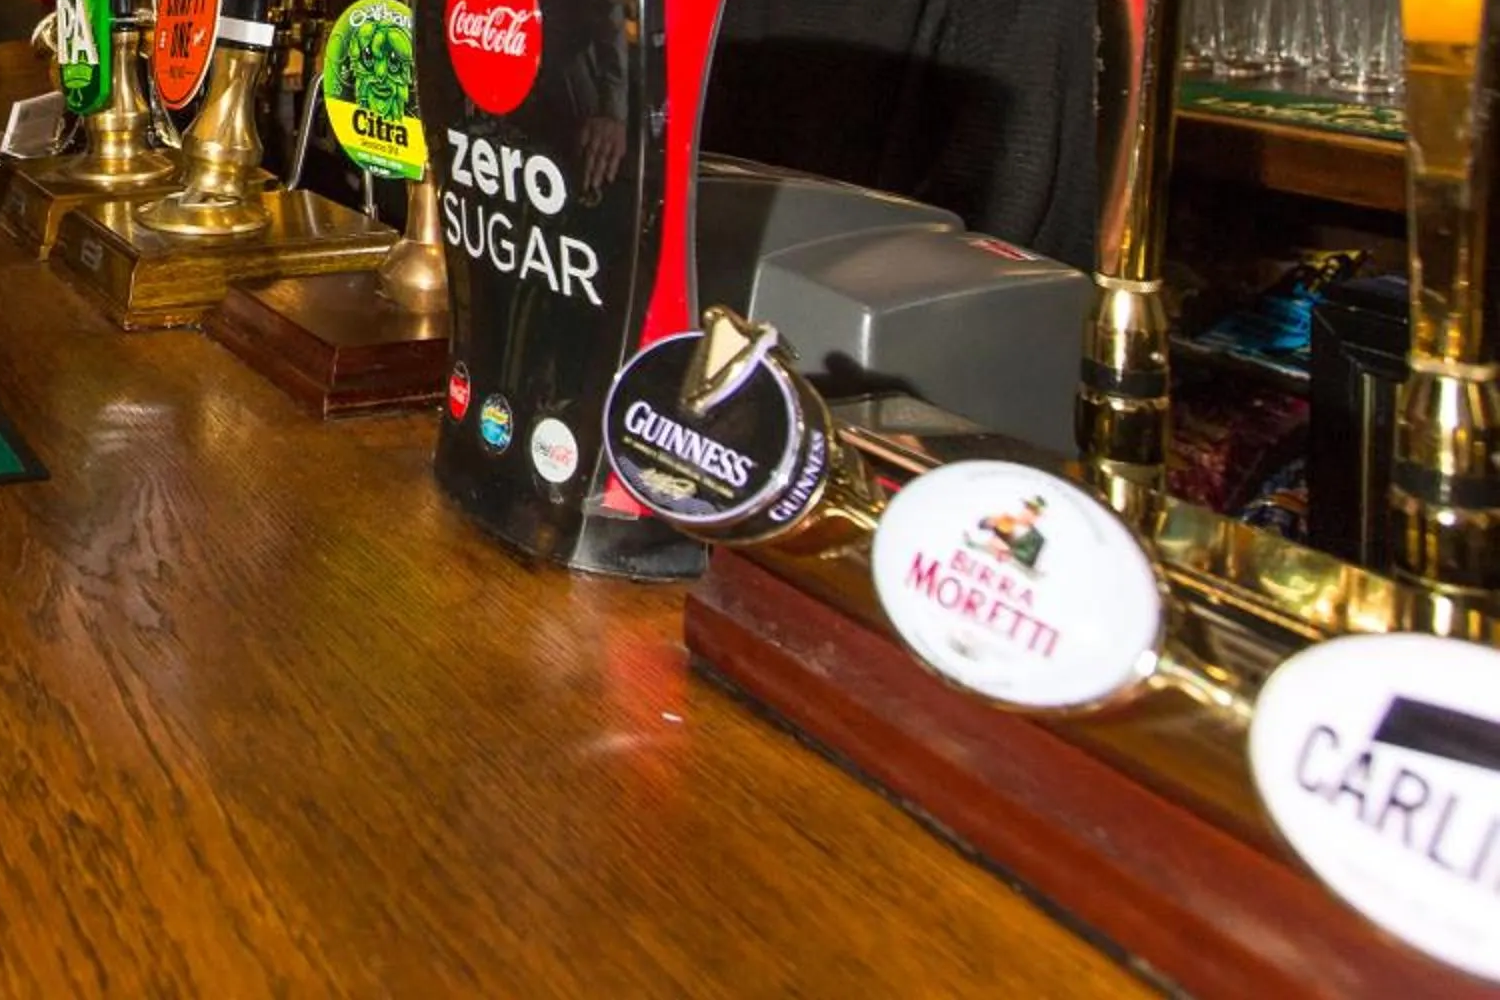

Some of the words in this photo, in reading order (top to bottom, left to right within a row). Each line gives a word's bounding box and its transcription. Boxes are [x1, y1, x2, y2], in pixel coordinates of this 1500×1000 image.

[449, 0, 542, 57] Coca-Cola
[352, 109, 409, 147] Citra
[447, 127, 568, 216] zero
[443, 190, 603, 306] SUGAR
[624, 400, 758, 488] GUINNESS
[768, 428, 825, 522] GUINNESS
[904, 550, 1061, 660] MORETTI
[949, 549, 1036, 609] BIRRA
[1296, 723, 1500, 900] CARLI
